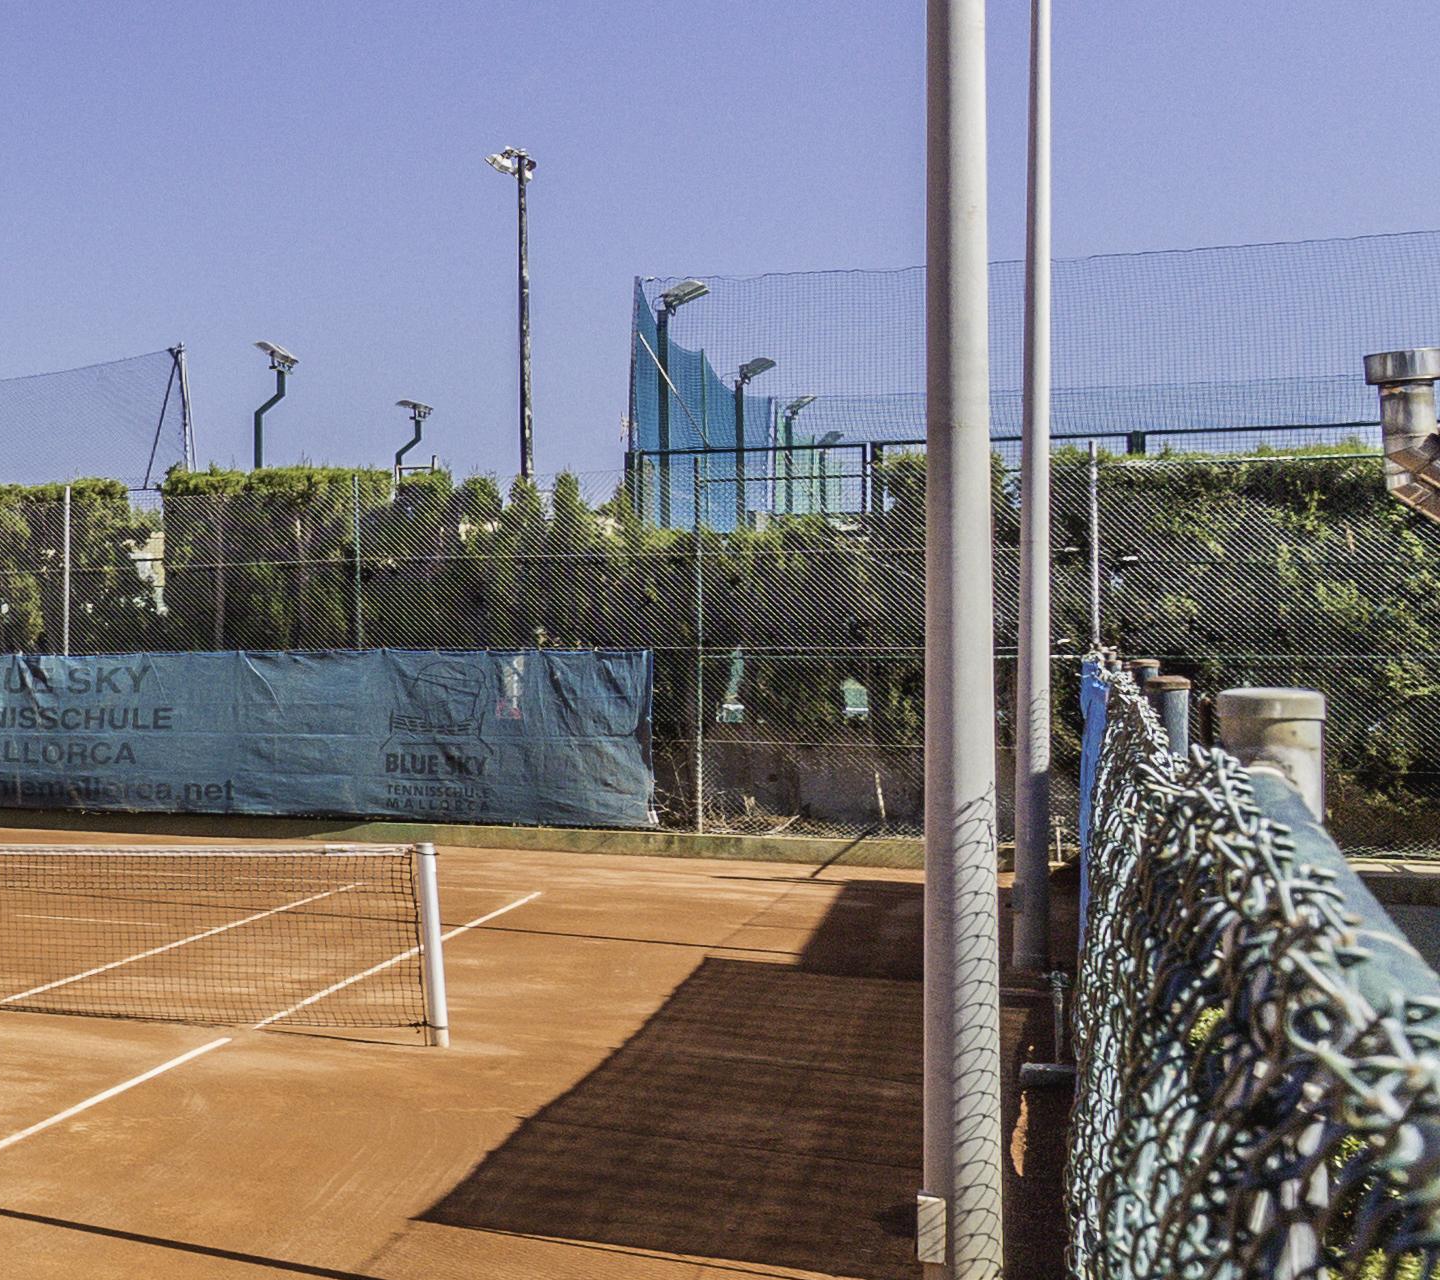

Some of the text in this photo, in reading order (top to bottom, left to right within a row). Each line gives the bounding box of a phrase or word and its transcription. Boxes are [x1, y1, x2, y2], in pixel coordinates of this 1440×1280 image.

[67, 665, 152, 694] SKY
[385, 753, 440, 774] BLUE
[386, 798, 491, 812] MALLORCA
